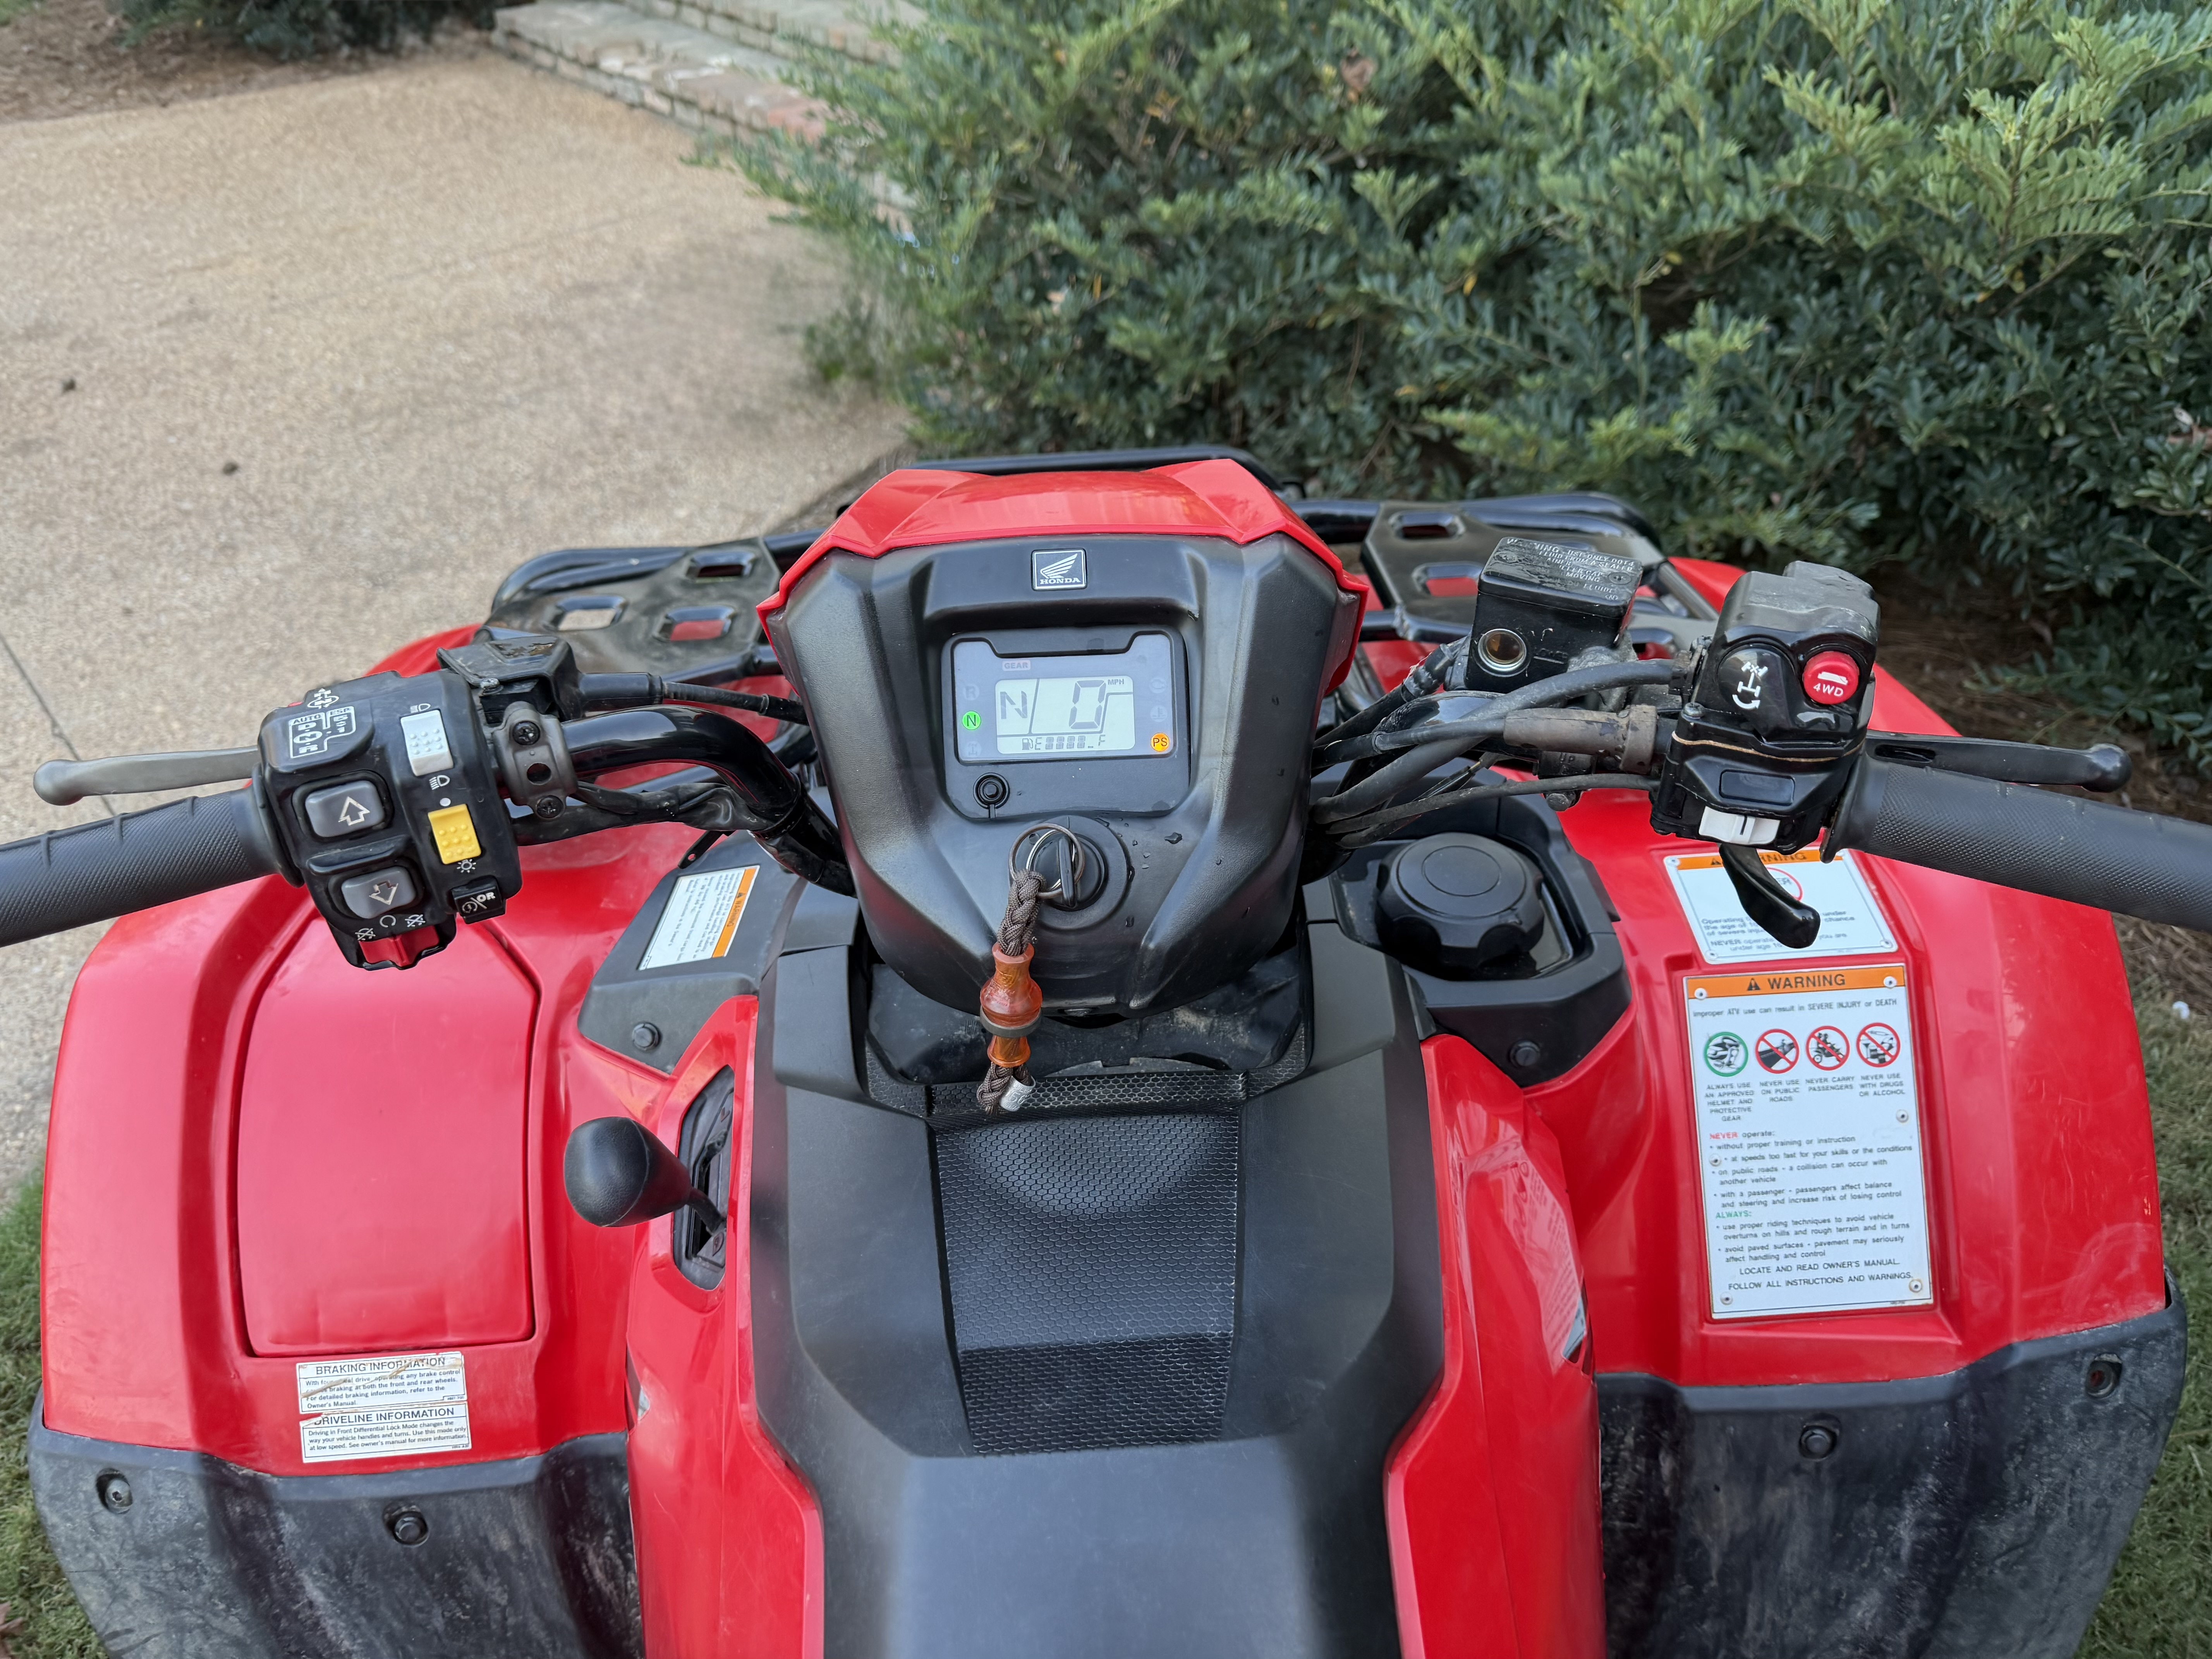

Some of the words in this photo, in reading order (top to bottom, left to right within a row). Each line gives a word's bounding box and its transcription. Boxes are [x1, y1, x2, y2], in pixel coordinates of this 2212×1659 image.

[1813, 683, 1844, 696] 4WD
[1000, 691, 1028, 719] N
[1068, 680, 1106, 729] 0
[293, 714, 321, 724] AUTO
[967, 714, 976, 726] N
[1153, 736, 1168, 747] PS
[476, 892, 496, 902] OR
[1767, 974, 1846, 990] WARNING
[1747, 1141, 1771, 1149] proper
[1731, 1167, 1754, 1176] public
[1796, 1163, 1827, 1171] collision
[1747, 1188, 1784, 1197] passenger
[1795, 1185, 1837, 1194] passengers
[1739, 1222, 1763, 1230] proper
[1739, 1266, 1771, 1275] LOCATE
[1822, 1260, 1860, 1269] OWNER'S
[1728, 1282, 1762, 1290] FOLLOW
[1785, 1276, 1844, 1286] INSTRUCTIONS
[316, 1363, 366, 1375] BRAKING
[313, 1413, 373, 1425] DRIVELINE
[376, 1407, 454, 1421] INFORMATION
